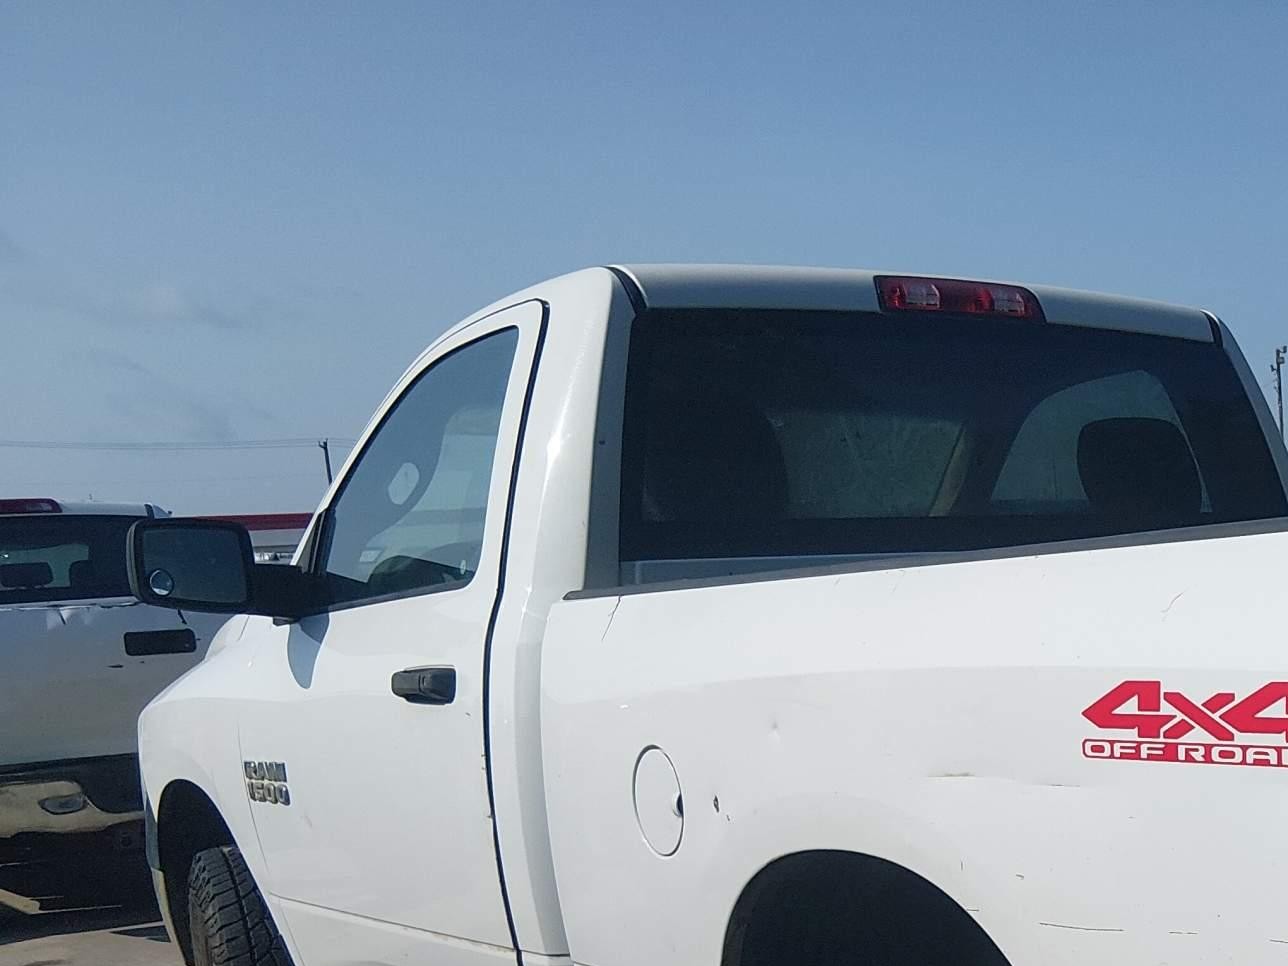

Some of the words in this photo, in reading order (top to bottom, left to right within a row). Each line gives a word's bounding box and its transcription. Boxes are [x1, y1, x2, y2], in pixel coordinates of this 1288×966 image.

[1084, 740, 1166, 761] OFF
[243, 760, 288, 783] RAM
[247, 780, 291, 807] 1500
